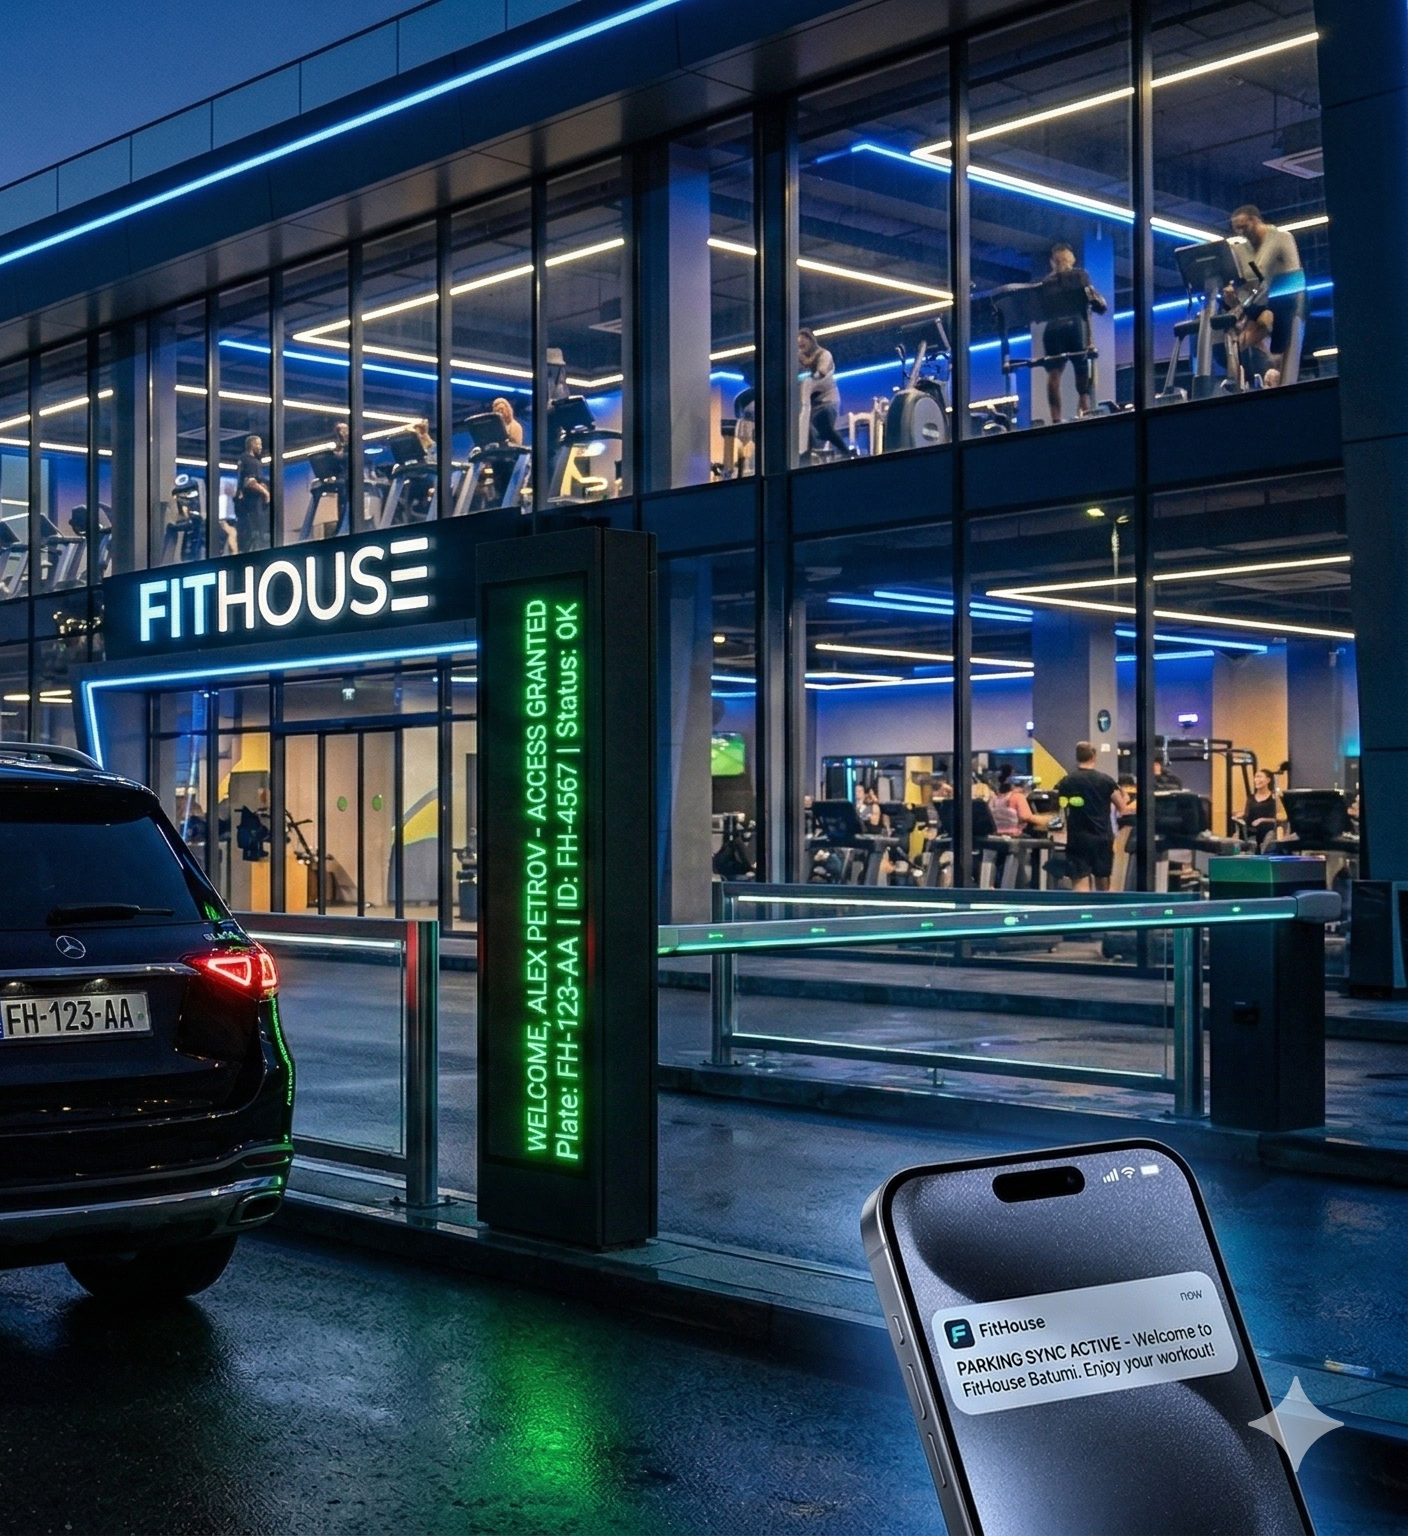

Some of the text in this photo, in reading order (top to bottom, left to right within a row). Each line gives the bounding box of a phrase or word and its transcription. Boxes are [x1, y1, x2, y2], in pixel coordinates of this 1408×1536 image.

[140, 537, 428, 641] FITHOUSE
[556, 603, 577, 640] OK
[527, 599, 546, 717] GRANTED
[556, 650, 577, 737] Status:
[527, 724, 547, 821] ACCESS
[557, 763, 578, 867] FH-4567
[528, 843, 547, 941] PETROV
[557, 877, 578, 907] ID:
[6, 998, 133, 1035] FH-123-AA
[528, 948, 547, 1014] ALEX
[557, 937, 578, 1078] FH-123-AA
[528, 1021, 551, 1152] WELCOME,
[555, 1087, 578, 1160] Plate:
[979, 1317, 1046, 1338] FitHouse
[1180, 1290, 1203, 1301] now
[956, 1352, 1023, 1376] PARKING
[1025, 1345, 1067, 1364] SYNC
[1070, 1335, 1122, 1358] ACTIVE
[1132, 1327, 1196, 1347] Welcome
[1197, 1323, 1213, 1337] to
[962, 1342, 1216, 1397] FitHouse Batumi. Enjoy your workout!
